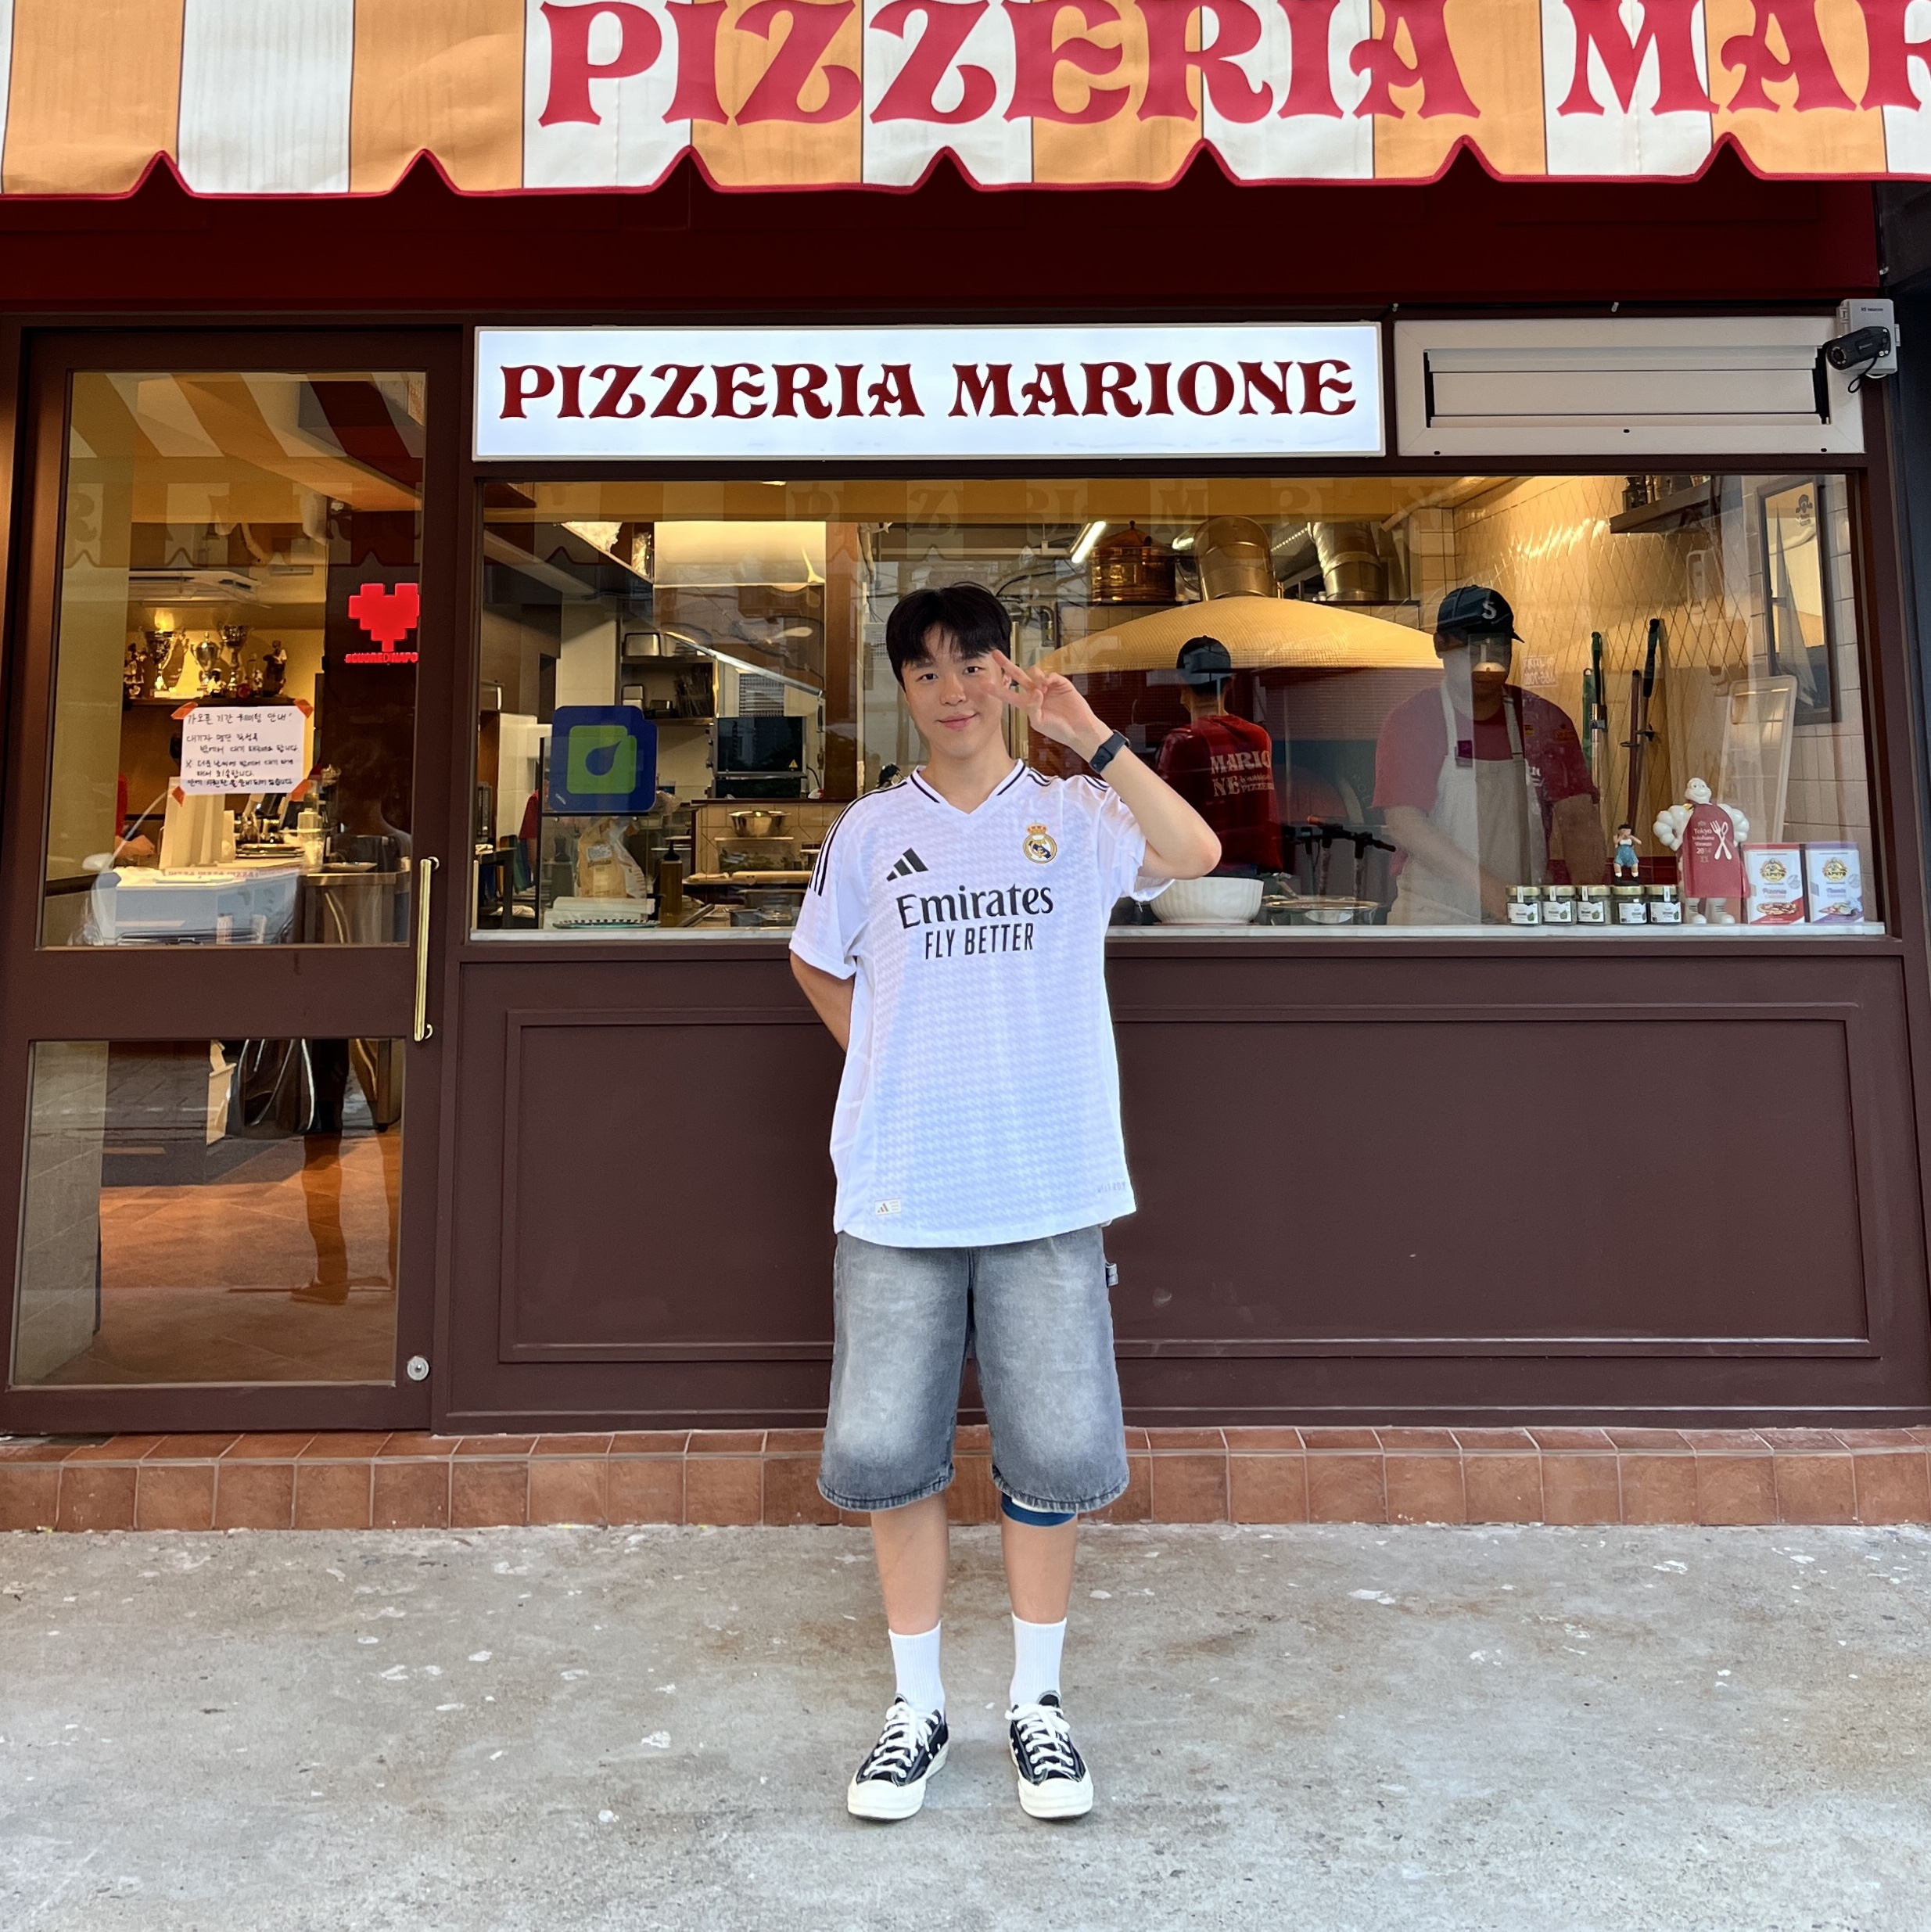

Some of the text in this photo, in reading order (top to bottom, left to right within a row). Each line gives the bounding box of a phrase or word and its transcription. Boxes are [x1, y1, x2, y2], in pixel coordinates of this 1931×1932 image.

[538, 0, 1481, 127] PIZZERIA
[499, 359, 1357, 419] PIZZERIA MARIONE
[186, 733, 214, 742] 대기자
[216, 733, 232, 742] 명단
[188, 713, 214, 724] 가오픈
[217, 713, 234, 724] 기간
[1211, 775, 1240, 796] NE
[896, 883, 1053, 929] Emirates
[925, 922, 1034, 960] FLY BETTER
